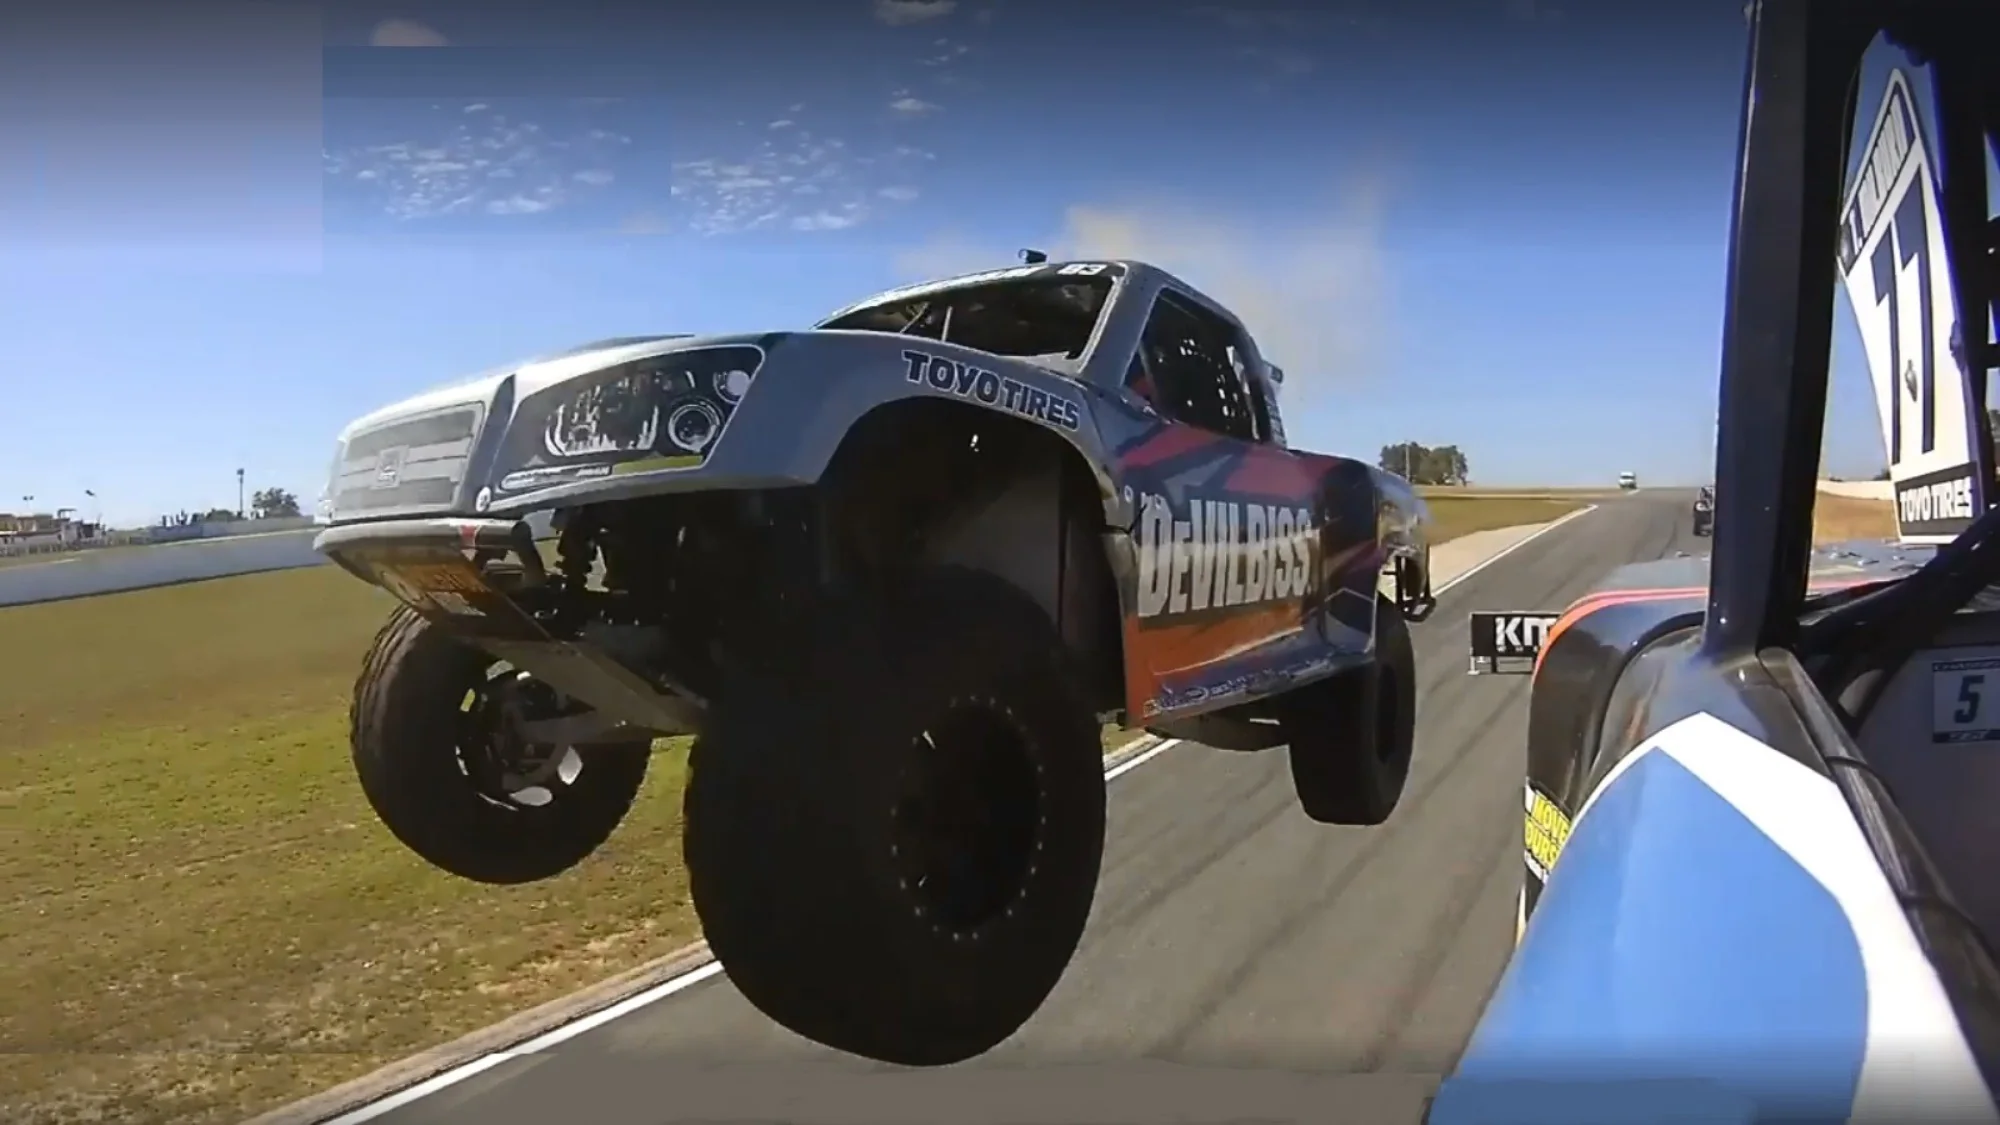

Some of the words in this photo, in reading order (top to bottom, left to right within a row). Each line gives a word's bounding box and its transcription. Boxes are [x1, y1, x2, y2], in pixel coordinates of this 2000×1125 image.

[903, 350, 1000, 405] TOYO
[1002, 376, 1080, 431] TIRES
[1899, 485, 1932, 523] TOYO
[1930, 475, 1973, 520] TIRES
[1954, 674, 1985, 723] 5
